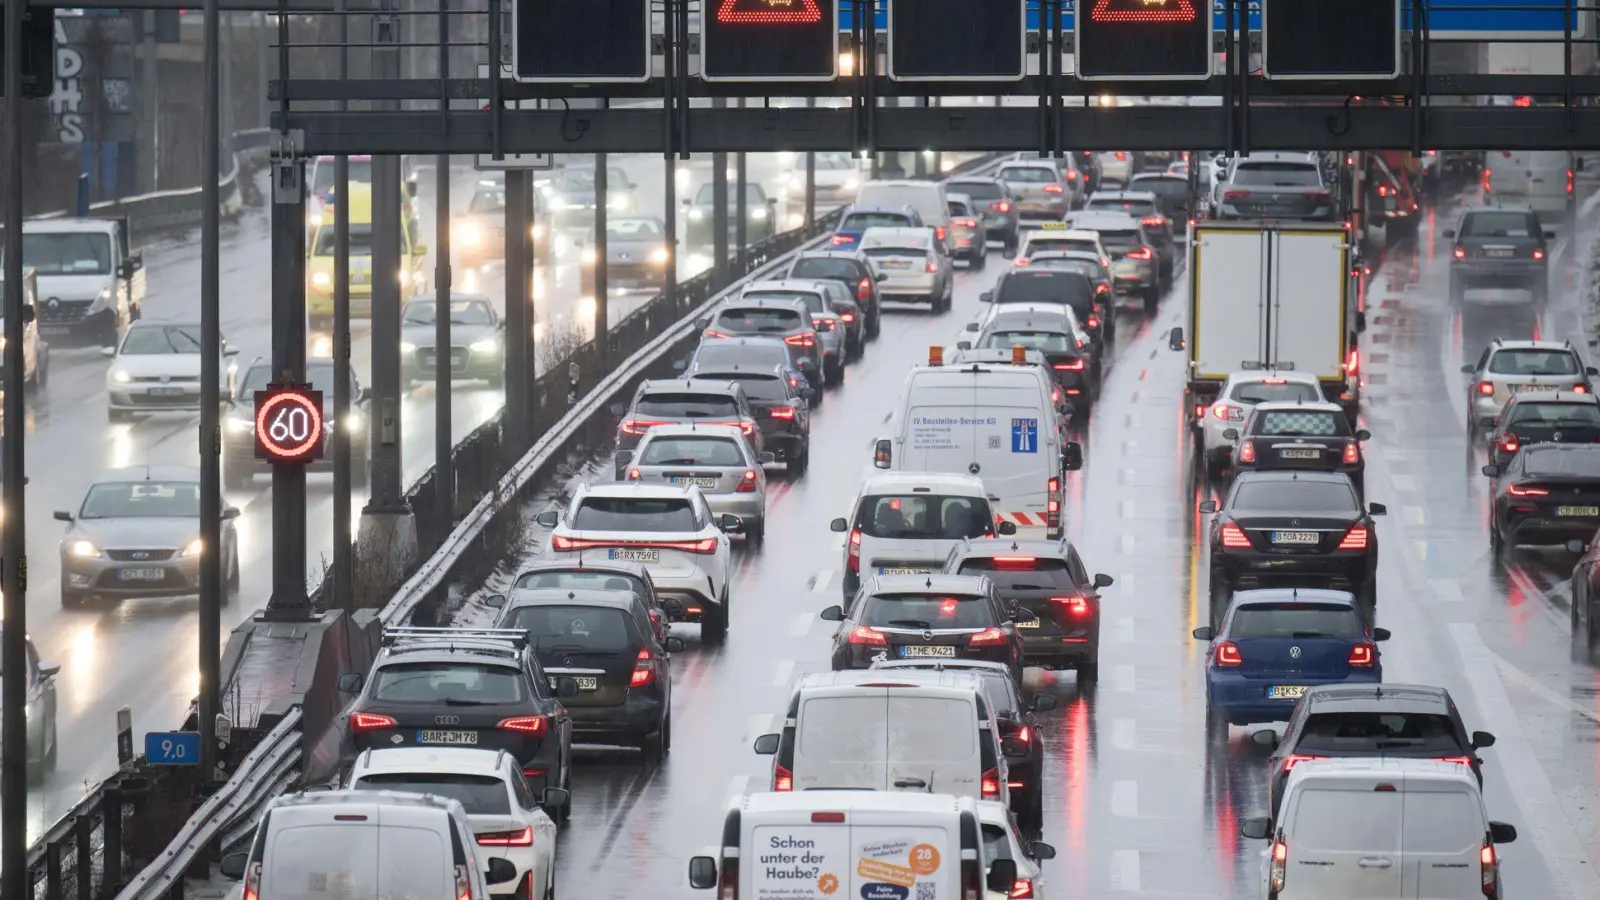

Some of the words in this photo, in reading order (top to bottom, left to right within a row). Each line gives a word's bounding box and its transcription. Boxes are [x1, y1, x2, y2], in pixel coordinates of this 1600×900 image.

[270, 407, 308, 441] 60
[624, 551, 635, 560] RX
[636, 551, 658, 560] 759E
[906, 646, 912, 655] B
[918, 646, 930, 655] ME
[931, 646, 954, 656] 9421
[1274, 687, 1280, 696] B
[1285, 687, 1298, 696] KS
[422, 731, 442, 742] BAR
[463, 732, 476, 743] 78
[161, 740, 186, 760] 9,0
[770, 835, 815, 849] Schon
[760, 852, 798, 864] unter
[801, 850, 826, 864] der
[916, 848, 932, 861] 28
[766, 865, 820, 879] Haube?
